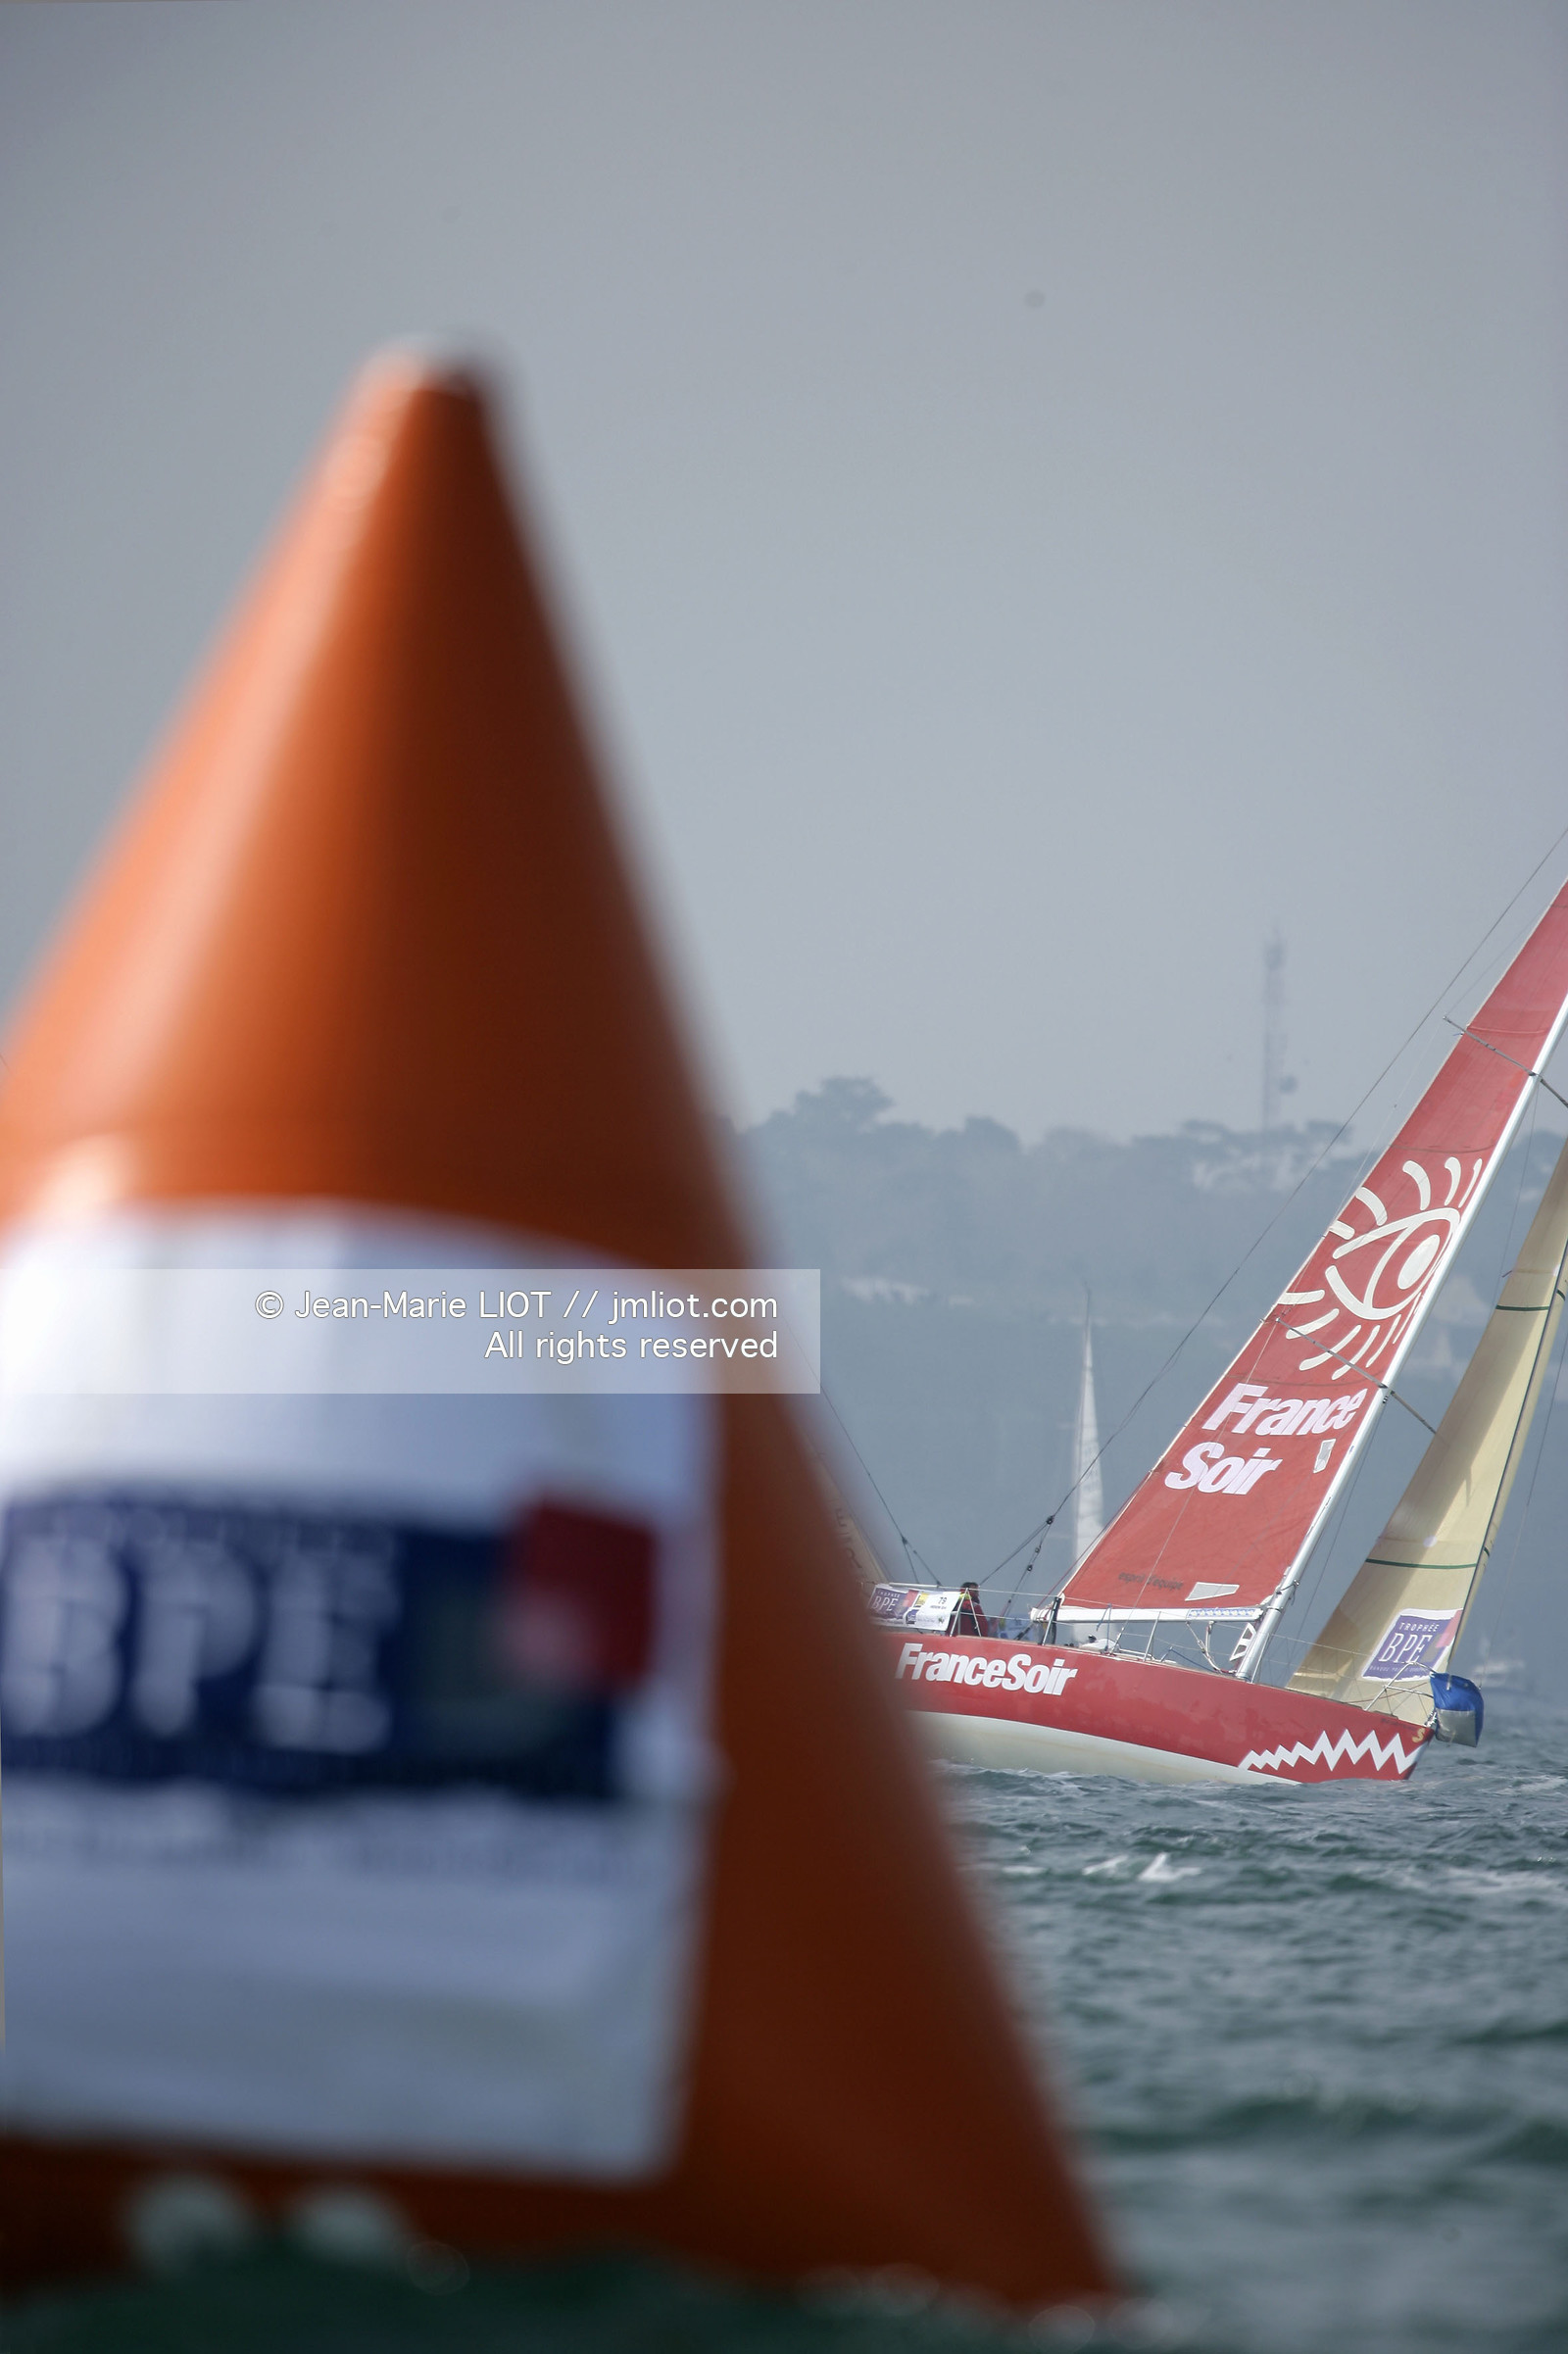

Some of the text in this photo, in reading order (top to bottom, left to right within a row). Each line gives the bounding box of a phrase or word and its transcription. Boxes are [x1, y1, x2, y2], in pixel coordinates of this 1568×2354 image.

[1201, 1383, 1368, 1436] France
[1164, 1442, 1283, 1495] Soir
[871, 1595, 899, 1612] BPE
[3, 1534, 397, 1754] BPE
[895, 1643, 1078, 1696] FranceSoir
[1378, 1633, 1433, 1664] BPE
